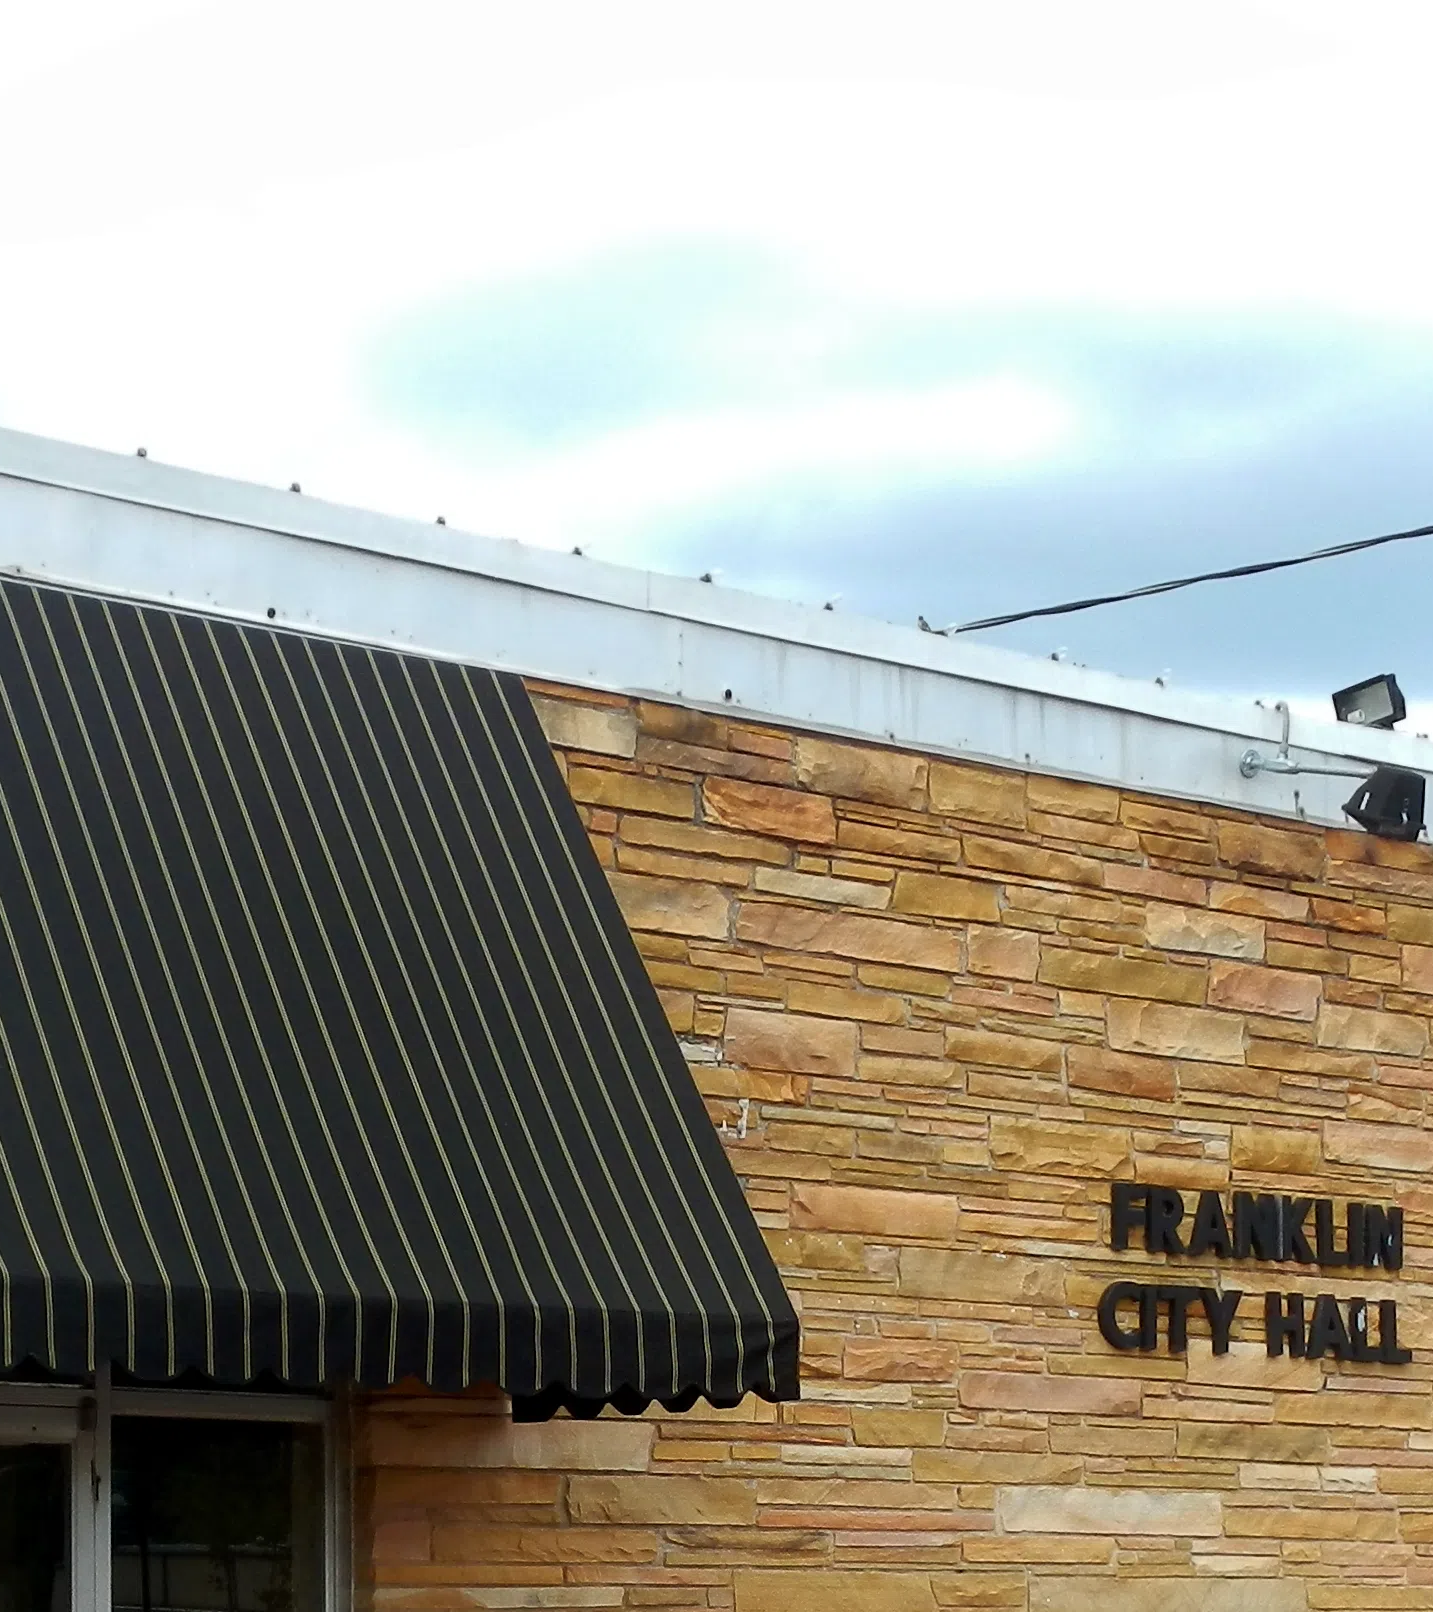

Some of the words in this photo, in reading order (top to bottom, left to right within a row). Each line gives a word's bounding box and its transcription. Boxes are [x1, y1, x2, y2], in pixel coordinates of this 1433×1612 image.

[1110, 1182, 1404, 1271] FRANKLIN
[1097, 1281, 1244, 1356] CITY
[1265, 1290, 1413, 1365] HALL
